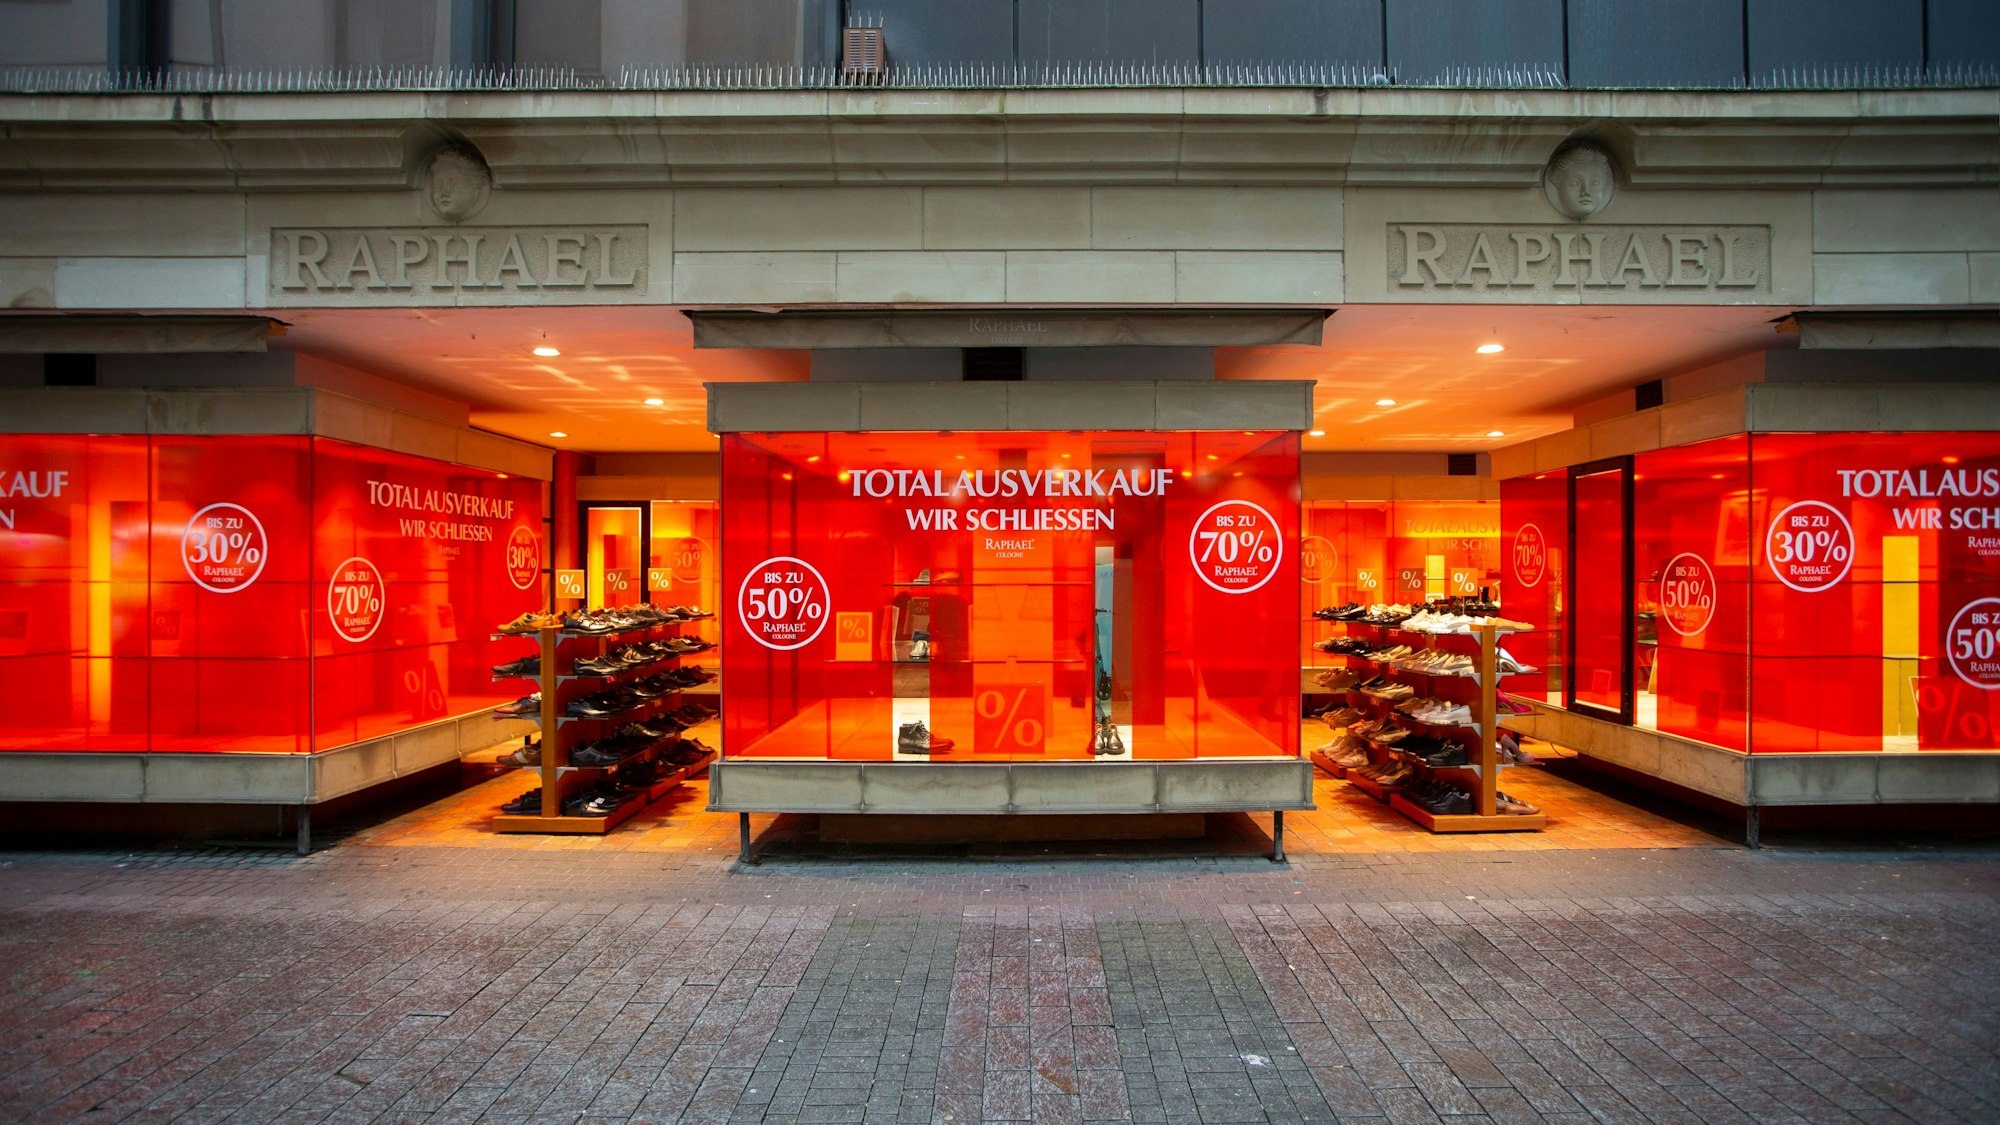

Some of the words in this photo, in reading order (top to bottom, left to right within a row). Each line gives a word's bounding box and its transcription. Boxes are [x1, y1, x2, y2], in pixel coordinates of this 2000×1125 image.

[282, 229, 639, 289] RAPHAEL
[1398, 225, 1761, 288] RAPHAEL
[969, 317, 1048, 333] RAPHAEL
[848, 468, 1174, 498] TOTALAUSVERKAUF
[367, 480, 514, 520] TOTALAUSVERKAUF
[206, 517, 223, 529] BIS
[226, 518, 244, 529] ZU
[399, 518, 426, 538] WIR
[429, 521, 493, 542] SCHLIESSEN
[905, 508, 959, 531] WIR
[966, 508, 1115, 531] SCHLIESSEN
[1216, 515, 1235, 527] BIS
[1237, 515, 1256, 527] ZU
[1791, 515, 1808, 527] BIS
[1811, 515, 1829, 527] ZU
[1892, 507, 1943, 530] WIR
[189, 532, 260, 565] 30%
[510, 545, 537, 569] 30%
[1200, 529, 1273, 563] 70%
[1516, 544, 1542, 567] 70%
[1774, 529, 1847, 563] 30%
[345, 571, 357, 582] BIS
[358, 571, 370, 581] ZU
[764, 572, 782, 584] BIS
[785, 572, 804, 584] ZU
[1675, 566, 1687, 577] BIS
[1688, 566, 1700, 577] ZU
[334, 583, 379, 615] 70%
[747, 586, 822, 620] 50%
[1665, 580, 1711, 610] 50%
[1971, 613, 1989, 624] BIS
[1955, 628, 2000, 660] 50
